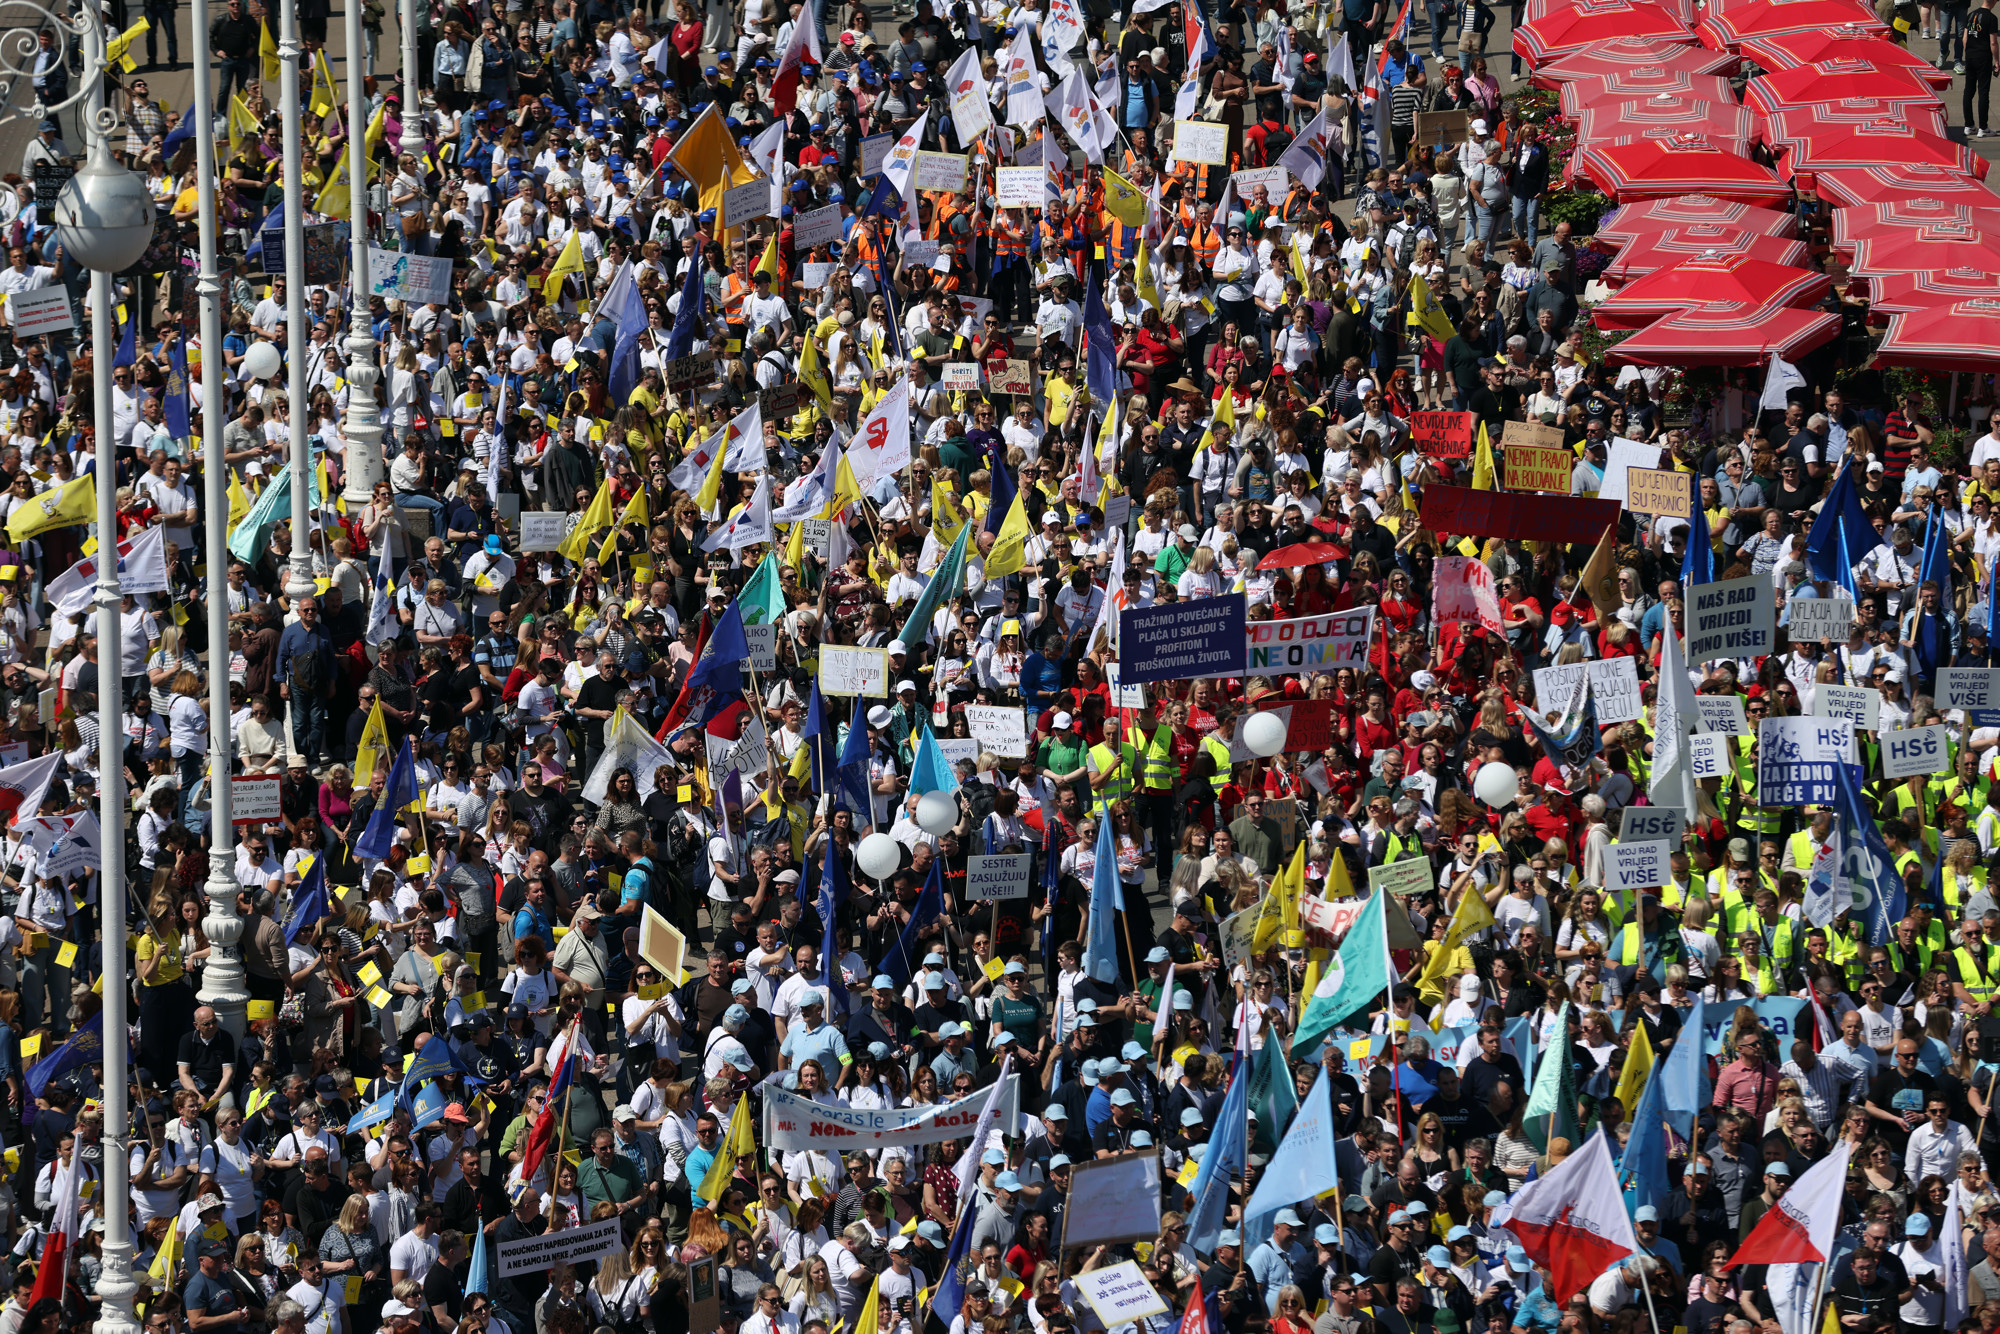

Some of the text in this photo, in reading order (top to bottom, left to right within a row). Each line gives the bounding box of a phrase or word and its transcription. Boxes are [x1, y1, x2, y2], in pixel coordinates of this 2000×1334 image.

[668, 358, 715, 381] SMO ZBOG
[1429, 431, 1446, 440] ALI
[1507, 451, 1569, 470] NEMAM PRAVO
[1507, 470, 1566, 491] NA BOLOVANJE
[1638, 472, 1689, 492] UMJETNICI
[1632, 492, 1688, 512] SU RADNICI
[813, 529, 826, 537] KAO
[1463, 562, 1487, 588] Mi
[1696, 585, 1756, 610] NAŠ RAD
[1176, 606, 1232, 624] POVEĆANJE
[1698, 609, 1751, 631] VRIJEDI
[746, 628, 768, 638] LIKO
[1138, 621, 1226, 643] PLAĆA U SKLADU S
[1279, 623, 1295, 640] O
[1301, 615, 1366, 640] DJECI
[749, 642, 766, 653] ŠTA
[1155, 639, 1203, 655] PROFITOM
[1690, 628, 1766, 656] PUNO VIŠE!
[1134, 650, 1232, 672] TROŠKOVIMA ŽIVOTA
[1246, 639, 1367, 669] INE O NAMA?
[741, 658, 774, 669] RAVLJE
[1598, 663, 1622, 678] ONE
[856, 668, 880, 683] VRIJEDI
[1949, 672, 1990, 680] MOJ RAD
[1592, 680, 1632, 700] GAJAJU
[1949, 682, 1989, 690] VRIJEDI
[1827, 690, 1866, 699] MOJ RAD
[1949, 690, 1987, 705] V!ŠE
[1827, 699, 1866, 709] VRIJEDI
[968, 709, 996, 720] PLAĆA
[1702, 709, 1735, 717] VRIJEDI
[985, 724, 1001, 732] KAO
[1704, 717, 1738, 732] V!ŠE
[1694, 738, 1712, 746] RAD
[1691, 747, 1714, 757] JEDI
[1693, 757, 1715, 774] ŠE
[1762, 765, 1833, 783] ZAJEDNO
[1762, 783, 1803, 803] VEĆE
[1616, 846, 1657, 856] MOJ RAD
[982, 858, 1018, 869] SESTRE
[1617, 855, 1657, 867] VRIJEDI
[971, 870, 1027, 883] ZASLUŽUJU
[1618, 867, 1657, 884] V!ŠE
[981, 884, 1015, 896] VIŠE!!!
[933, 1108, 1002, 1128] kolae
[778, 1121, 797, 1132] MA:
[501, 1226, 617, 1258] MOGUĆNOST NAPREDOVANJA ZA SVE,
[507, 1262, 512, 1270] A
[512, 1260, 522, 1268] NE
[522, 1256, 542, 1267] SAMO
[543, 1254, 551, 1263] ZA
[552, 1252, 567, 1262] NEKE
